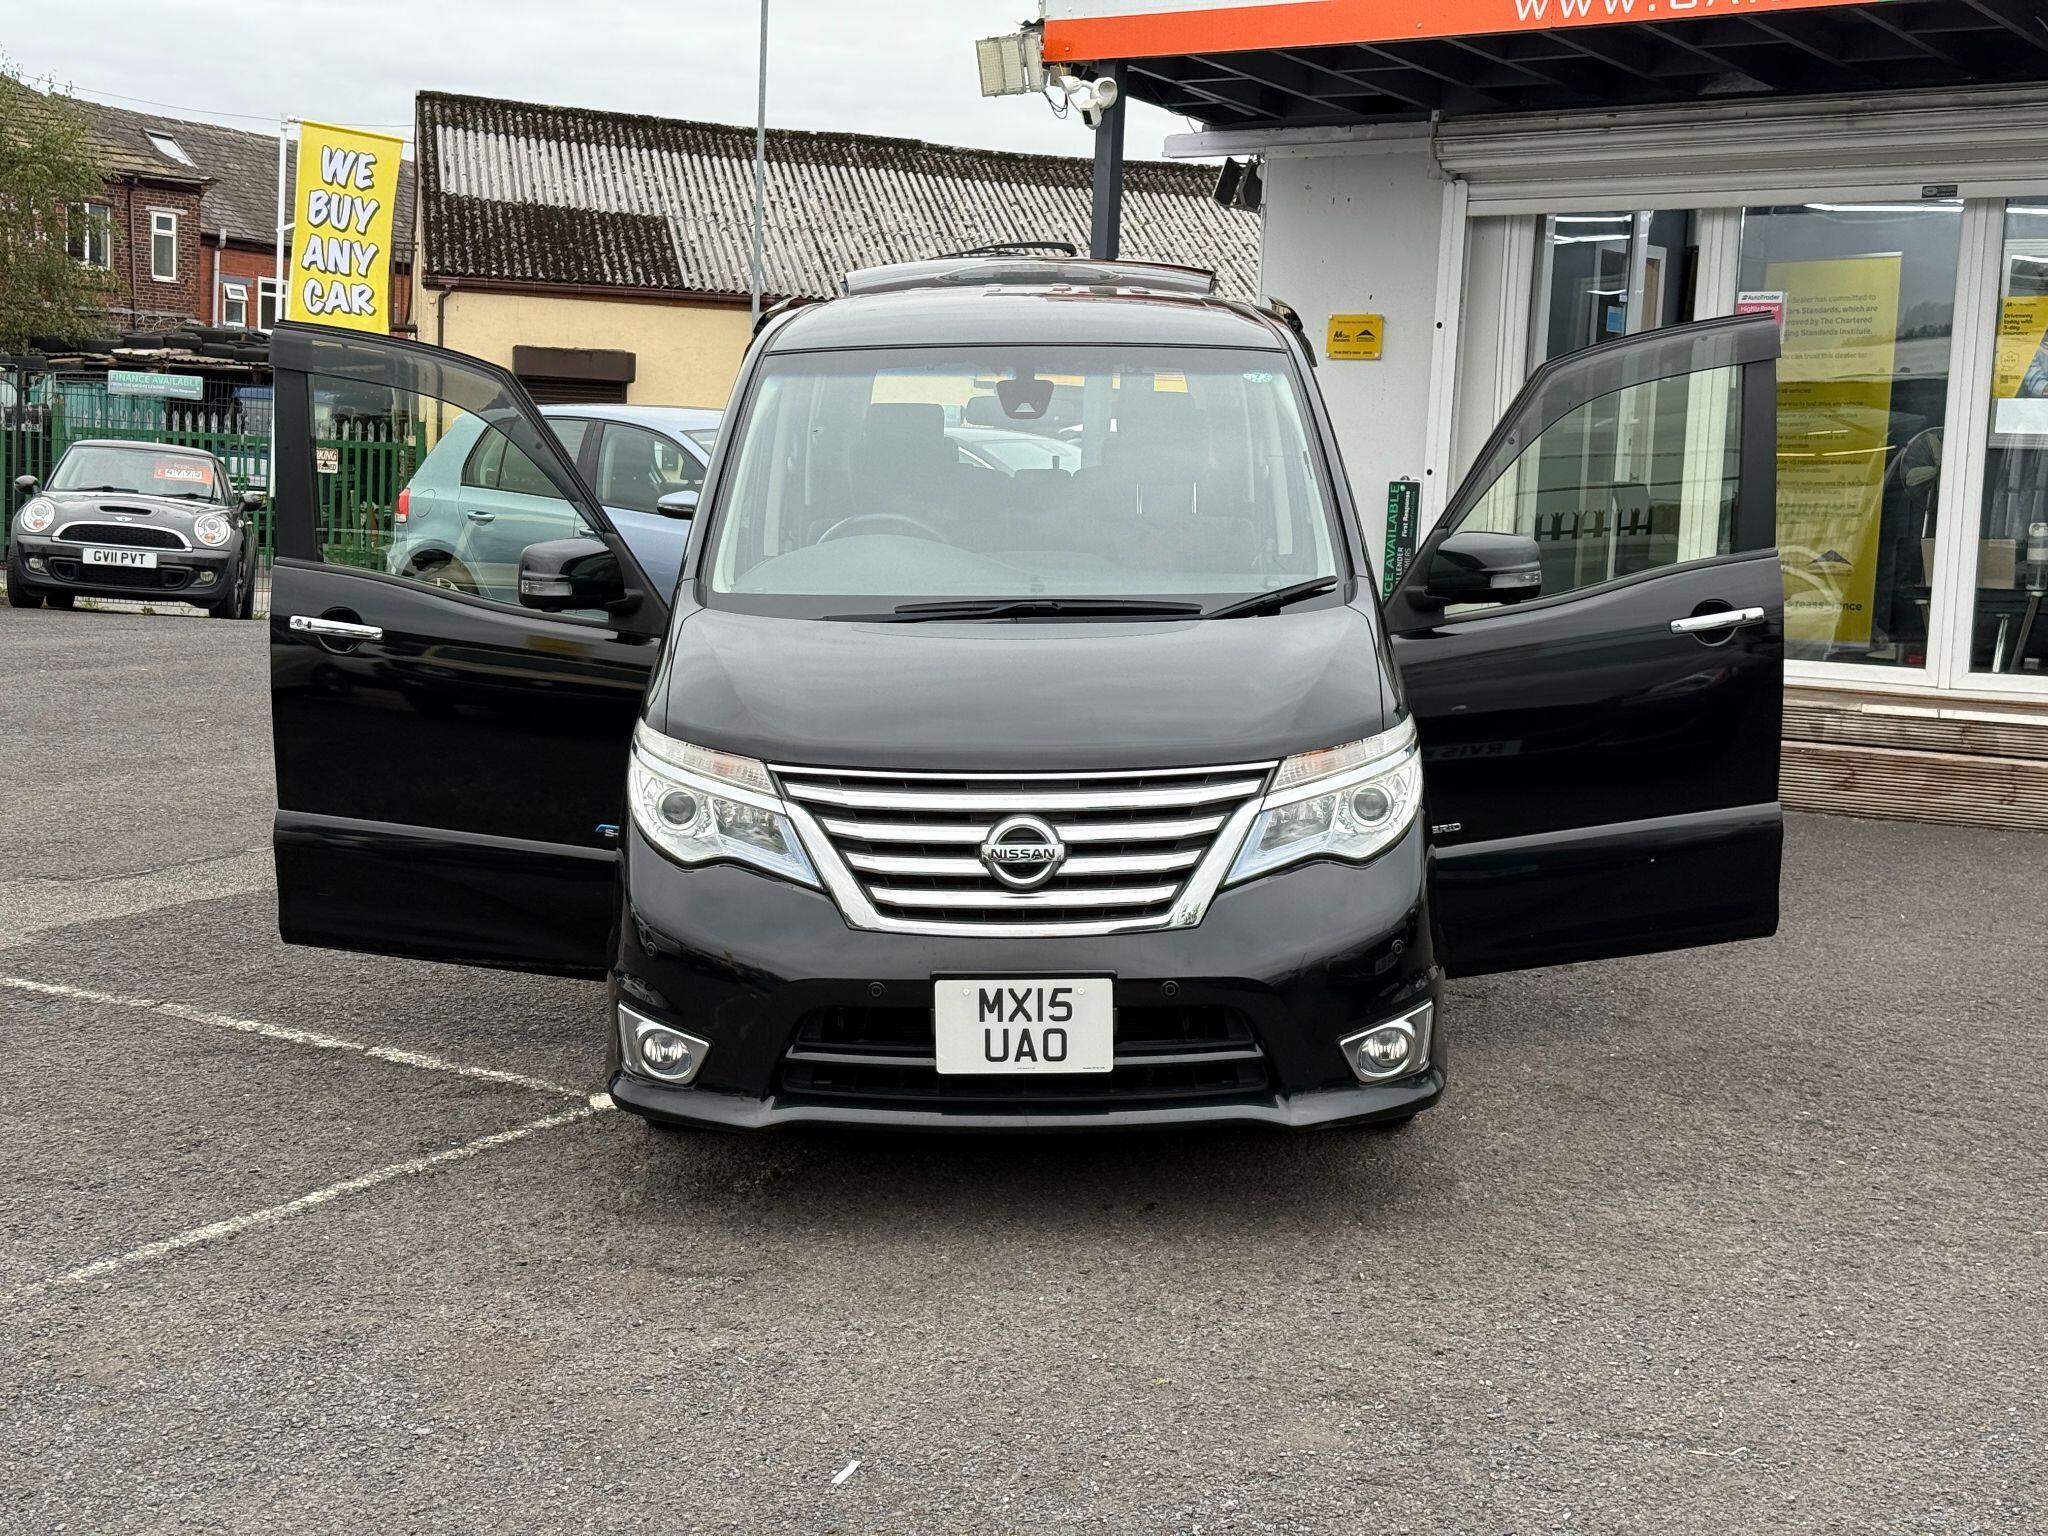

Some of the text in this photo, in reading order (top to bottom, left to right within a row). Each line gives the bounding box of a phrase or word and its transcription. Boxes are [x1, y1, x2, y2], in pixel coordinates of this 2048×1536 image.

[1514, 0, 1780, 21] WWW.
[320, 145, 377, 191] WE
[307, 189, 380, 235] BUY
[301, 233, 379, 278] ANY
[303, 278, 377, 316] CAR
[1740, 305, 1759, 313] Highly
[1802, 307, 1841, 315] Standards,
[1810, 318, 1819, 326] by
[1835, 316, 1873, 324] Chartered
[110, 371, 150, 384] FINANCE
[151, 376, 201, 388] AVAILABLE
[1403, 490, 1411, 522] Response
[1386, 484, 1400, 569] AVAILABLE
[94, 550, 146, 565] GV11 PVT
[1396, 546, 1404, 576] LENDER
[1795, 600, 1863, 612] reassrance
[990, 848, 1056, 860] NISSAN
[978, 987, 1073, 1023] MX15
[984, 1027, 1068, 1063] UAO
